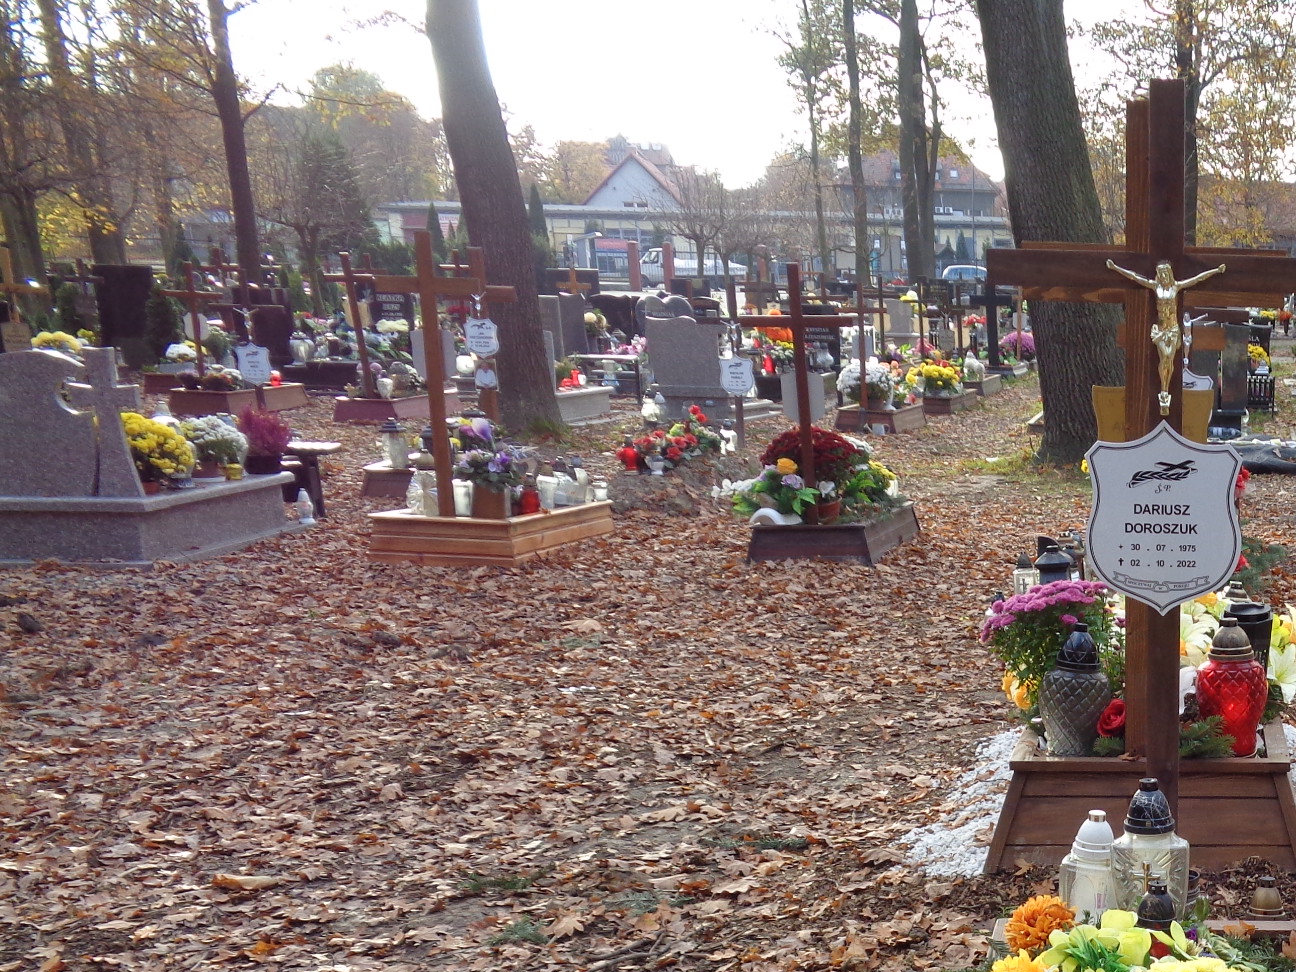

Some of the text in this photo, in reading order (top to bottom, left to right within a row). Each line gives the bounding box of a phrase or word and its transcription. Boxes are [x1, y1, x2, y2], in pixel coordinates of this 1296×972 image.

[1133, 503, 1191, 516] DARIUSZ
[1124, 522, 1198, 535] DOROSZUK
[1130, 543, 1141, 551] 30
[1155, 543, 1167, 552] 07
[1178, 544, 1197, 553] 1975
[1130, 559, 1141, 567] 02
[1156, 560, 1165, 568] 10
[1176, 560, 1197, 568] 2022
